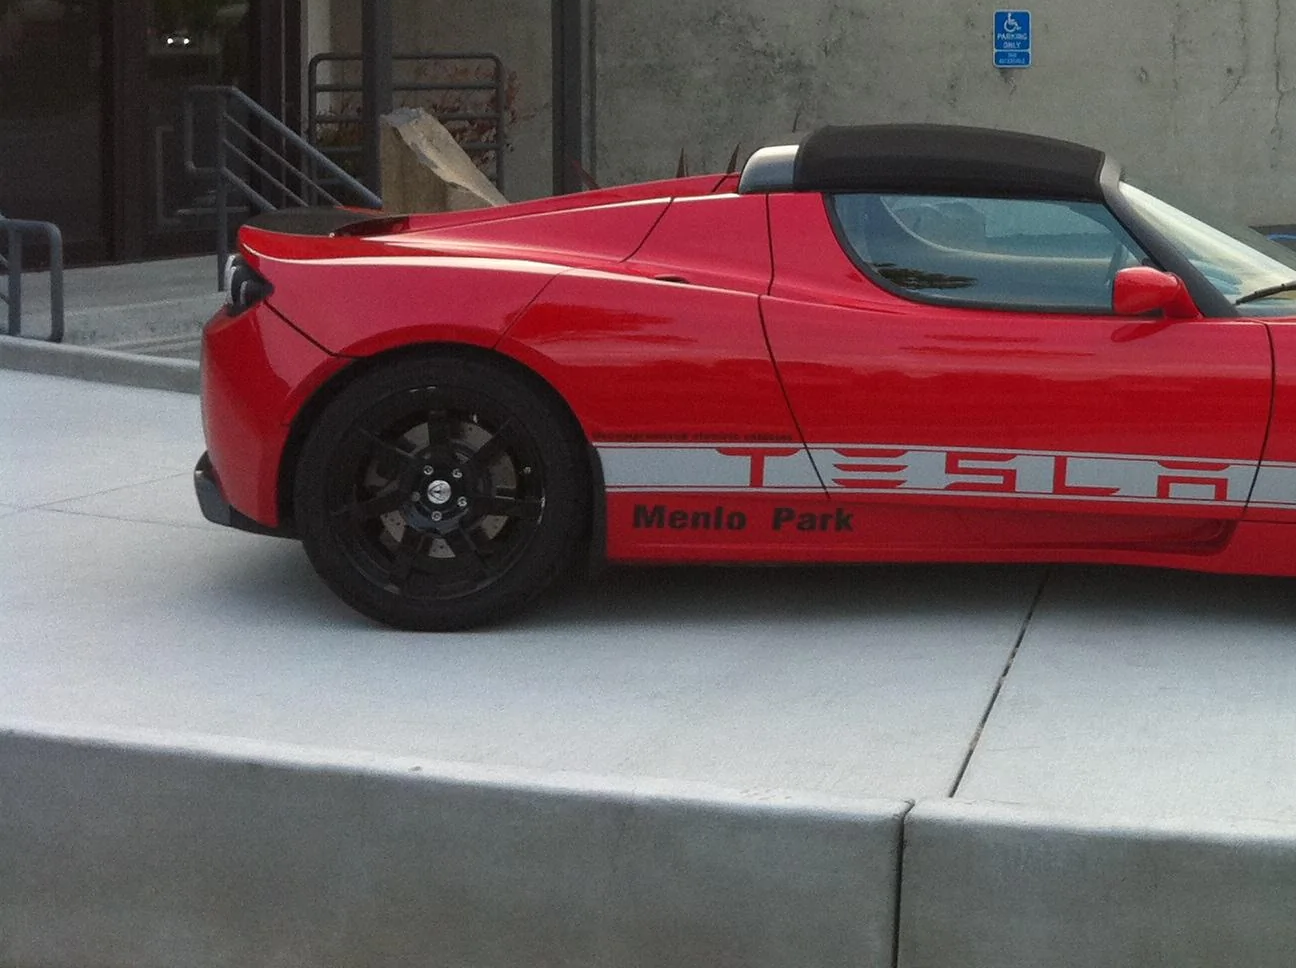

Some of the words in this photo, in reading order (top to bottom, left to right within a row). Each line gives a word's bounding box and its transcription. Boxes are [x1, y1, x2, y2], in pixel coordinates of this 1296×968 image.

[715, 447, 1231, 501] TESLA
[633, 503, 747, 530] Menlo
[772, 506, 855, 532] Park
